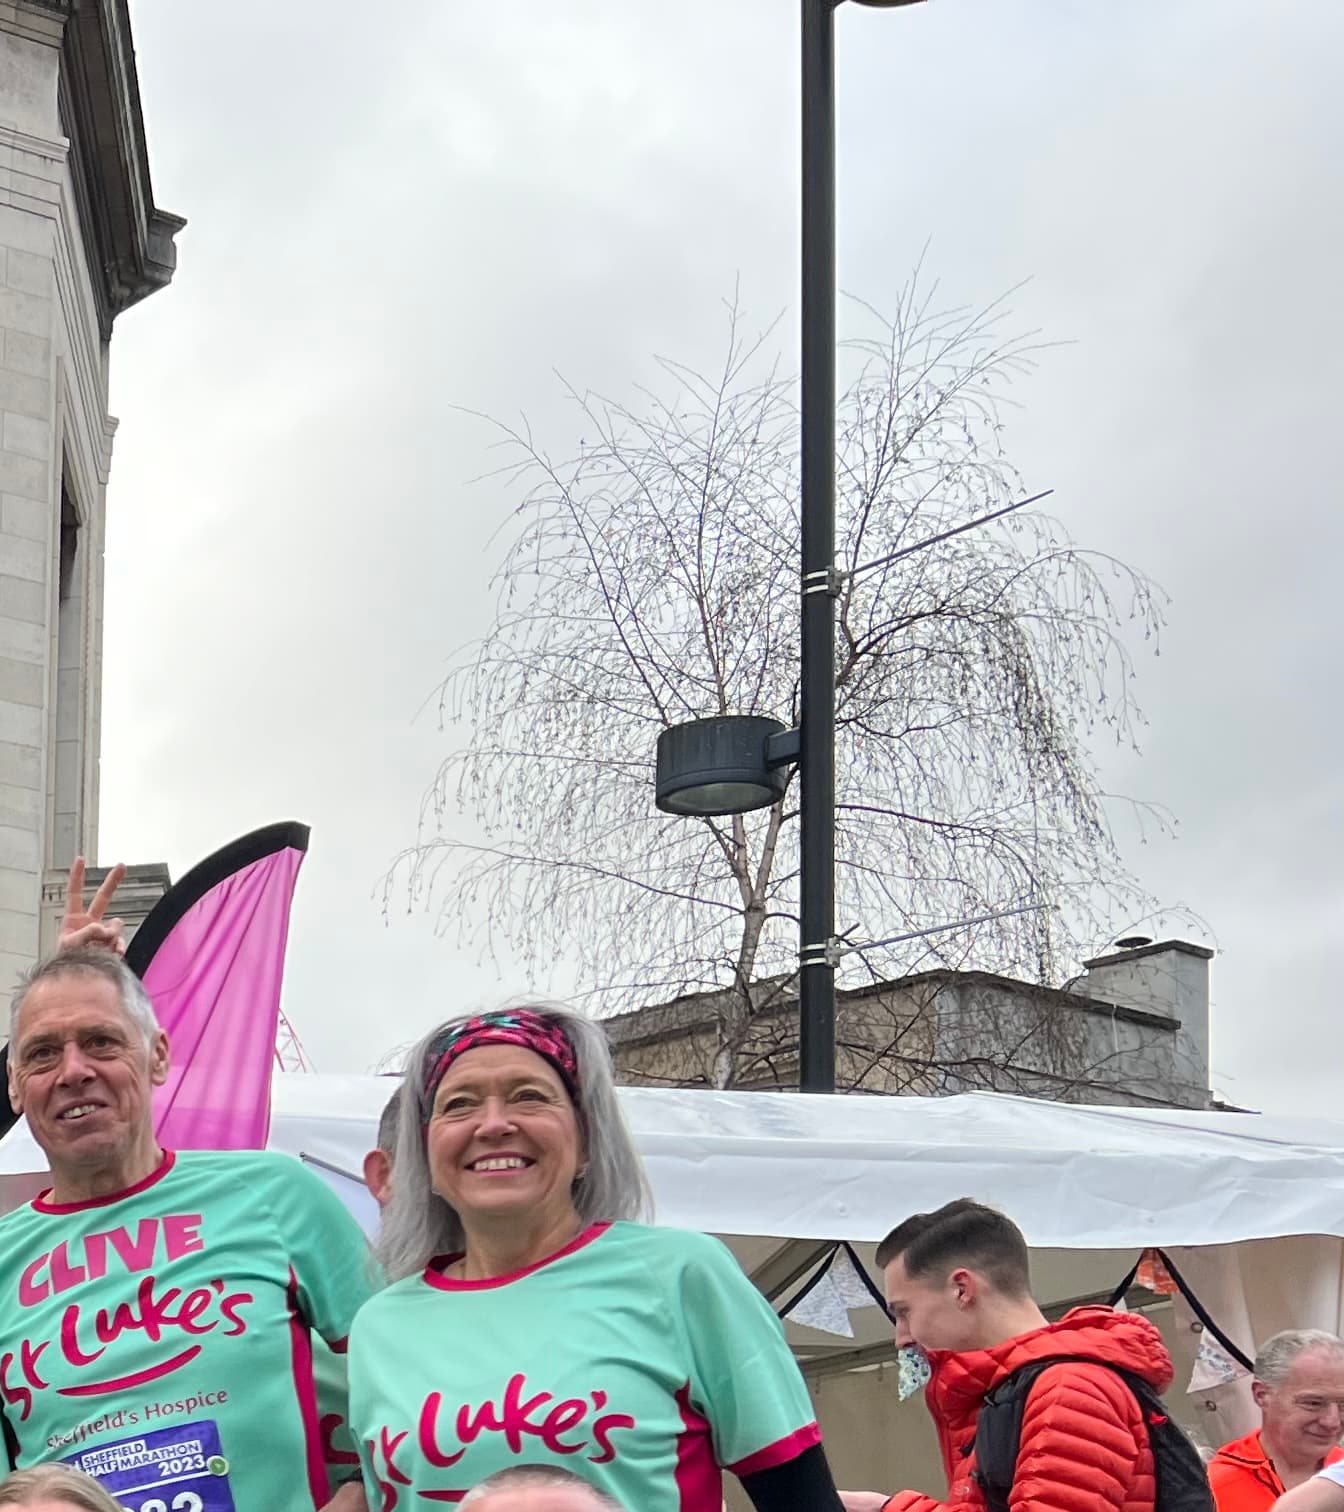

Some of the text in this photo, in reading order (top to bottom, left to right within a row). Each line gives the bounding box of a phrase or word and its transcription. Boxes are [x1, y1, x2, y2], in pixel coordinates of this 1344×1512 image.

[19, 1214, 204, 1307] CLIVE
[60, 1275, 254, 1366] Luke's
[145, 1390, 229, 1419] Hospice
[419, 1373, 636, 1468] Luke's
[84, 1443, 144, 1466] SHEFFIELD
[85, 1442, 200, 1477] HALF MARATHON
[158, 1455, 206, 1477] 2023
